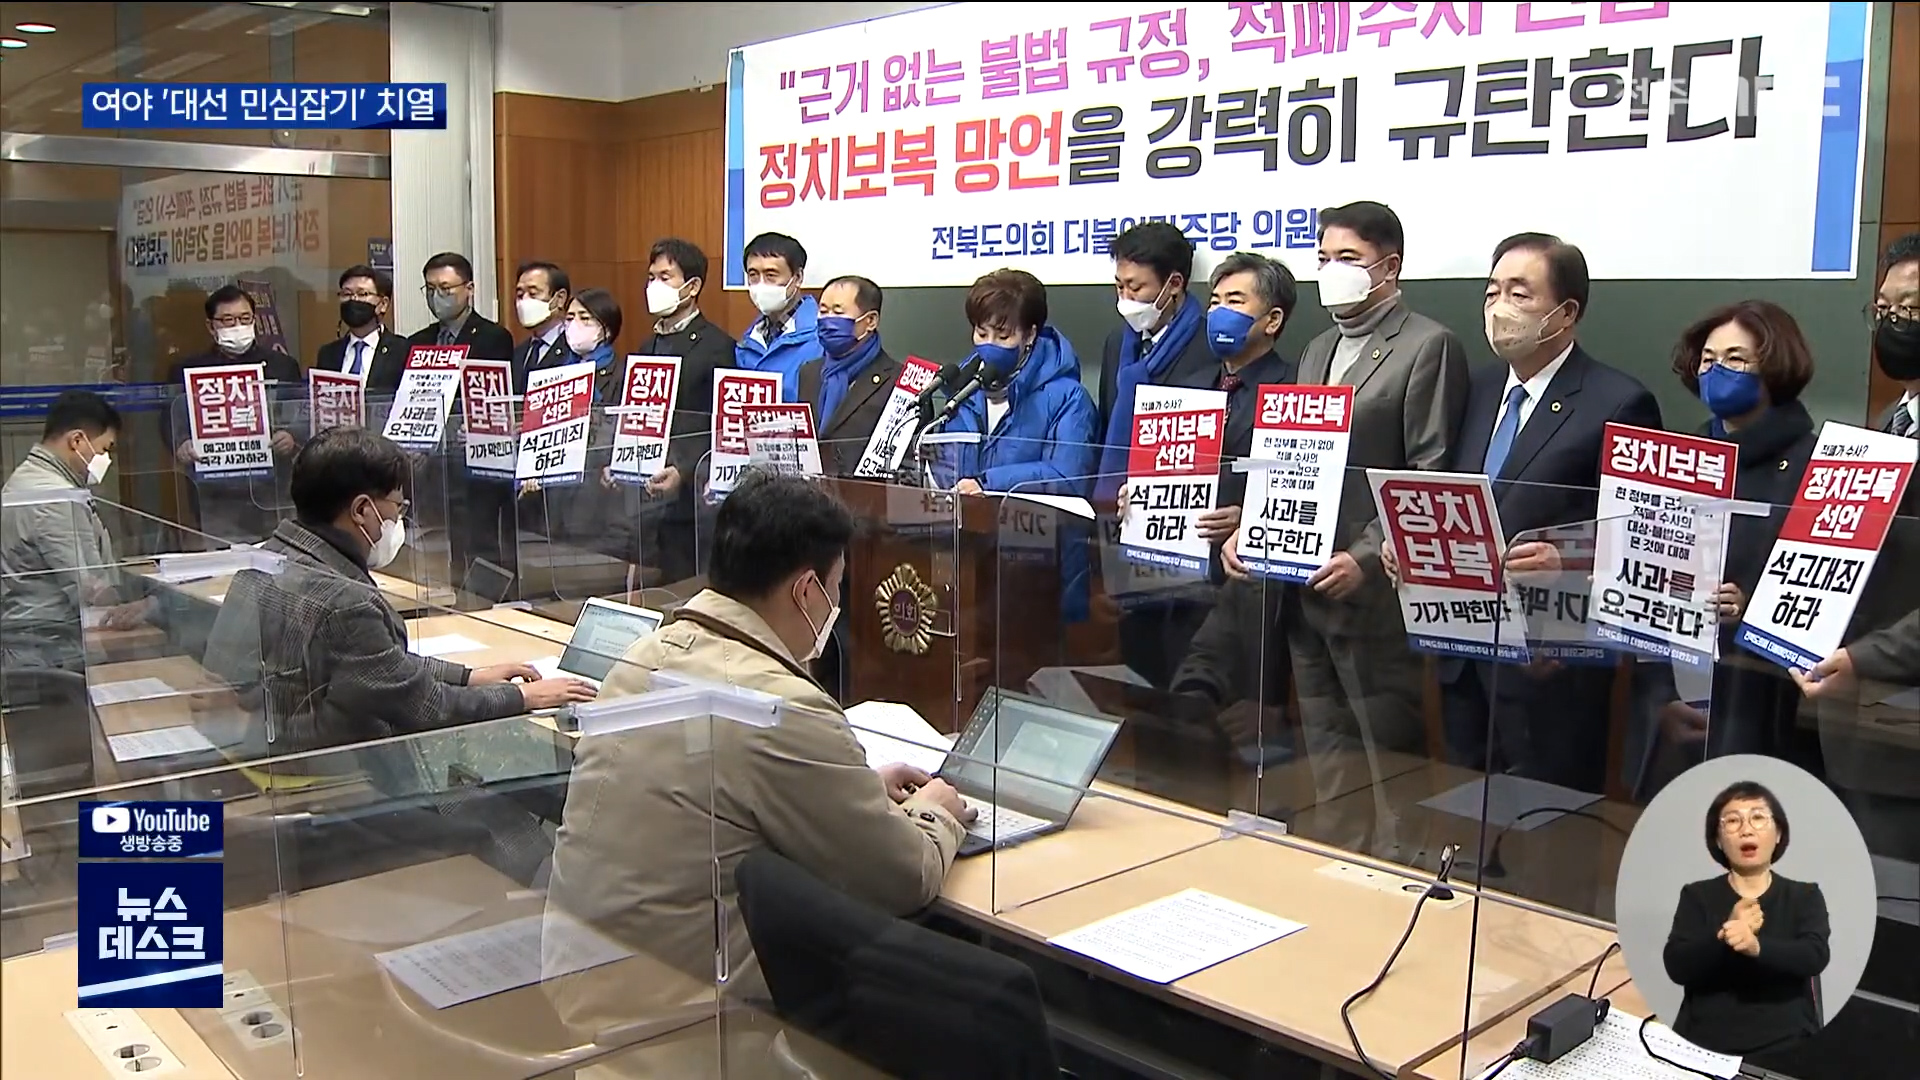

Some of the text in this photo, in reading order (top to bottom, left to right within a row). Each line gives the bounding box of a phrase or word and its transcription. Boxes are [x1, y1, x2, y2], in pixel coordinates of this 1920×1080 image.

[780, 59, 868, 123] "근거
[883, 50, 964, 112] 없는
[980, 27, 1068, 96] 불법
[1088, 8, 1209, 82] 규정,
[760, 125, 936, 209] 정치보복
[955, 105, 1125, 193] 망언을
[1146, 77, 1357, 178] 강력히
[1388, 35, 1774, 160] 규탄한다
[931, 220, 1054, 260] 전북도의회
[1251, 207, 1317, 249] 의원
[410, 349, 463, 368] 정치보복
[196, 375, 254, 406] 정치
[316, 381, 356, 409] 정치
[467, 371, 504, 398] 정치
[528, 377, 588, 410] 정치보복
[631, 368, 671, 398] 정치
[723, 381, 773, 414] 정치
[202, 405, 258, 433] 보복
[399, 407, 437, 421] 사과를
[542, 401, 572, 424] 선언
[623, 402, 666, 433] 보복
[1261, 392, 1345, 426] 정치보복
[388, 422, 437, 438] 요구한다
[522, 422, 584, 453] 석고대죄
[1138, 413, 1217, 445] 정치보복
[470, 443, 487, 459] 기가
[616, 447, 634, 462] 기가
[1155, 444, 1195, 472] 선언
[1300, 439, 1316, 450] 근거
[535, 449, 566, 471] 하라
[1611, 435, 1726, 490] 정치보복
[1129, 483, 1211, 510] 석고대죄
[1615, 486, 1627, 500] 현
[1629, 489, 1661, 507] 정부를
[1803, 466, 1901, 503] 정치보복
[1260, 497, 1318, 526] 사과를
[1389, 488, 1484, 536] 정치
[1659, 512, 1692, 529] 수사의
[1811, 503, 1864, 540] 선언
[1146, 515, 1187, 541] 하라
[1246, 526, 1323, 556] 요구한다
[1404, 536, 1494, 585] 보복
[1643, 538, 1665, 554] 것에
[1667, 544, 1690, 560] 대해
[1616, 557, 1696, 602] 사과를
[1768, 550, 1864, 594] 석고대죄
[1410, 601, 1512, 624] 기가 막힌다
[1599, 587, 1705, 640] 요구한다
[1771, 591, 1823, 631] 하라
